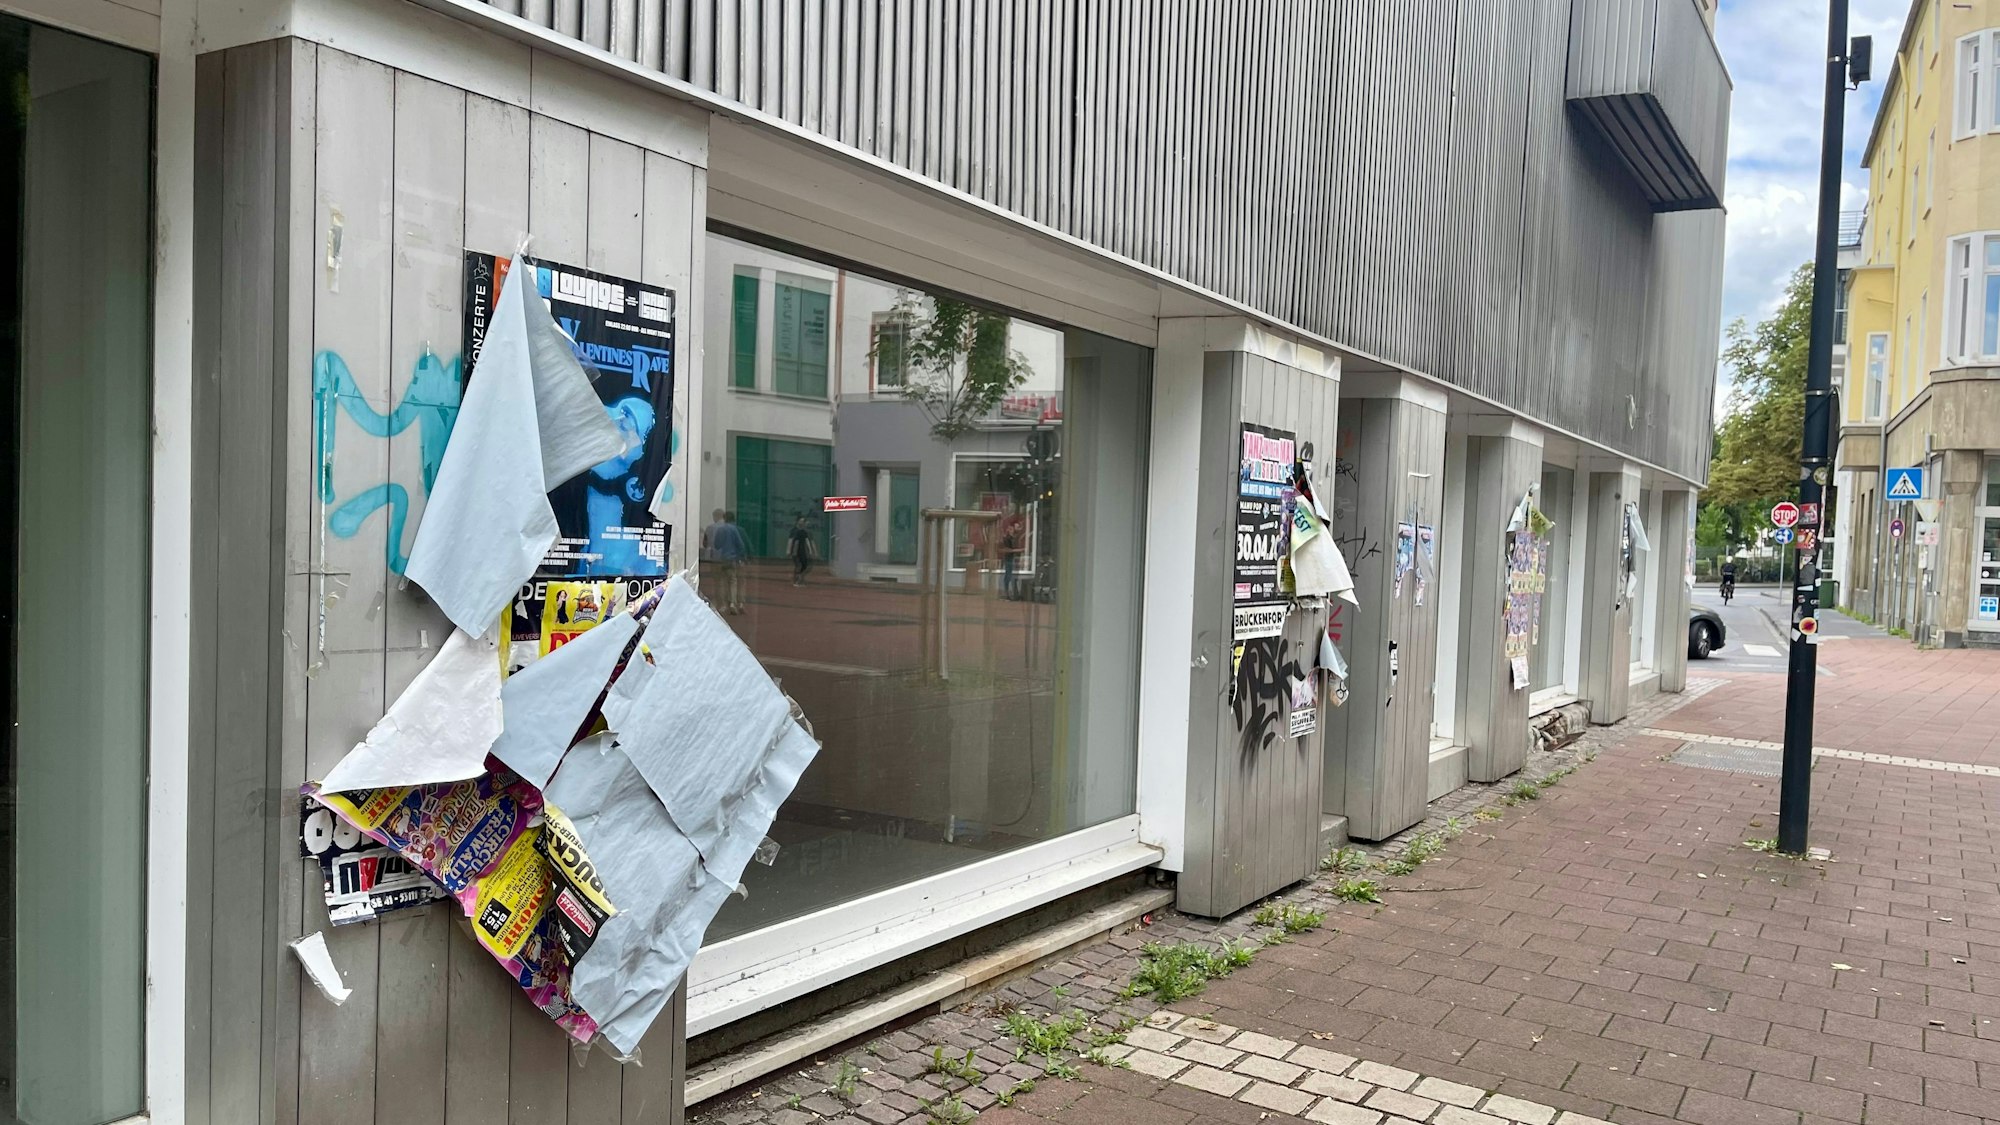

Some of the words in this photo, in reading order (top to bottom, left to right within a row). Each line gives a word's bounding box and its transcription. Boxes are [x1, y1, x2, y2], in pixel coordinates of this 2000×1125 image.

[473, 284, 486, 366] ONZERTE
[559, 316, 634, 367] VLENTINES
[1774, 509, 1797, 521] STOP
[1235, 611, 1286, 627] BRÜCKENFOR
[450, 808, 506, 880] FREIWALD
[463, 824, 511, 881] CIRCUS
[560, 894, 595, 934] bonnticket
